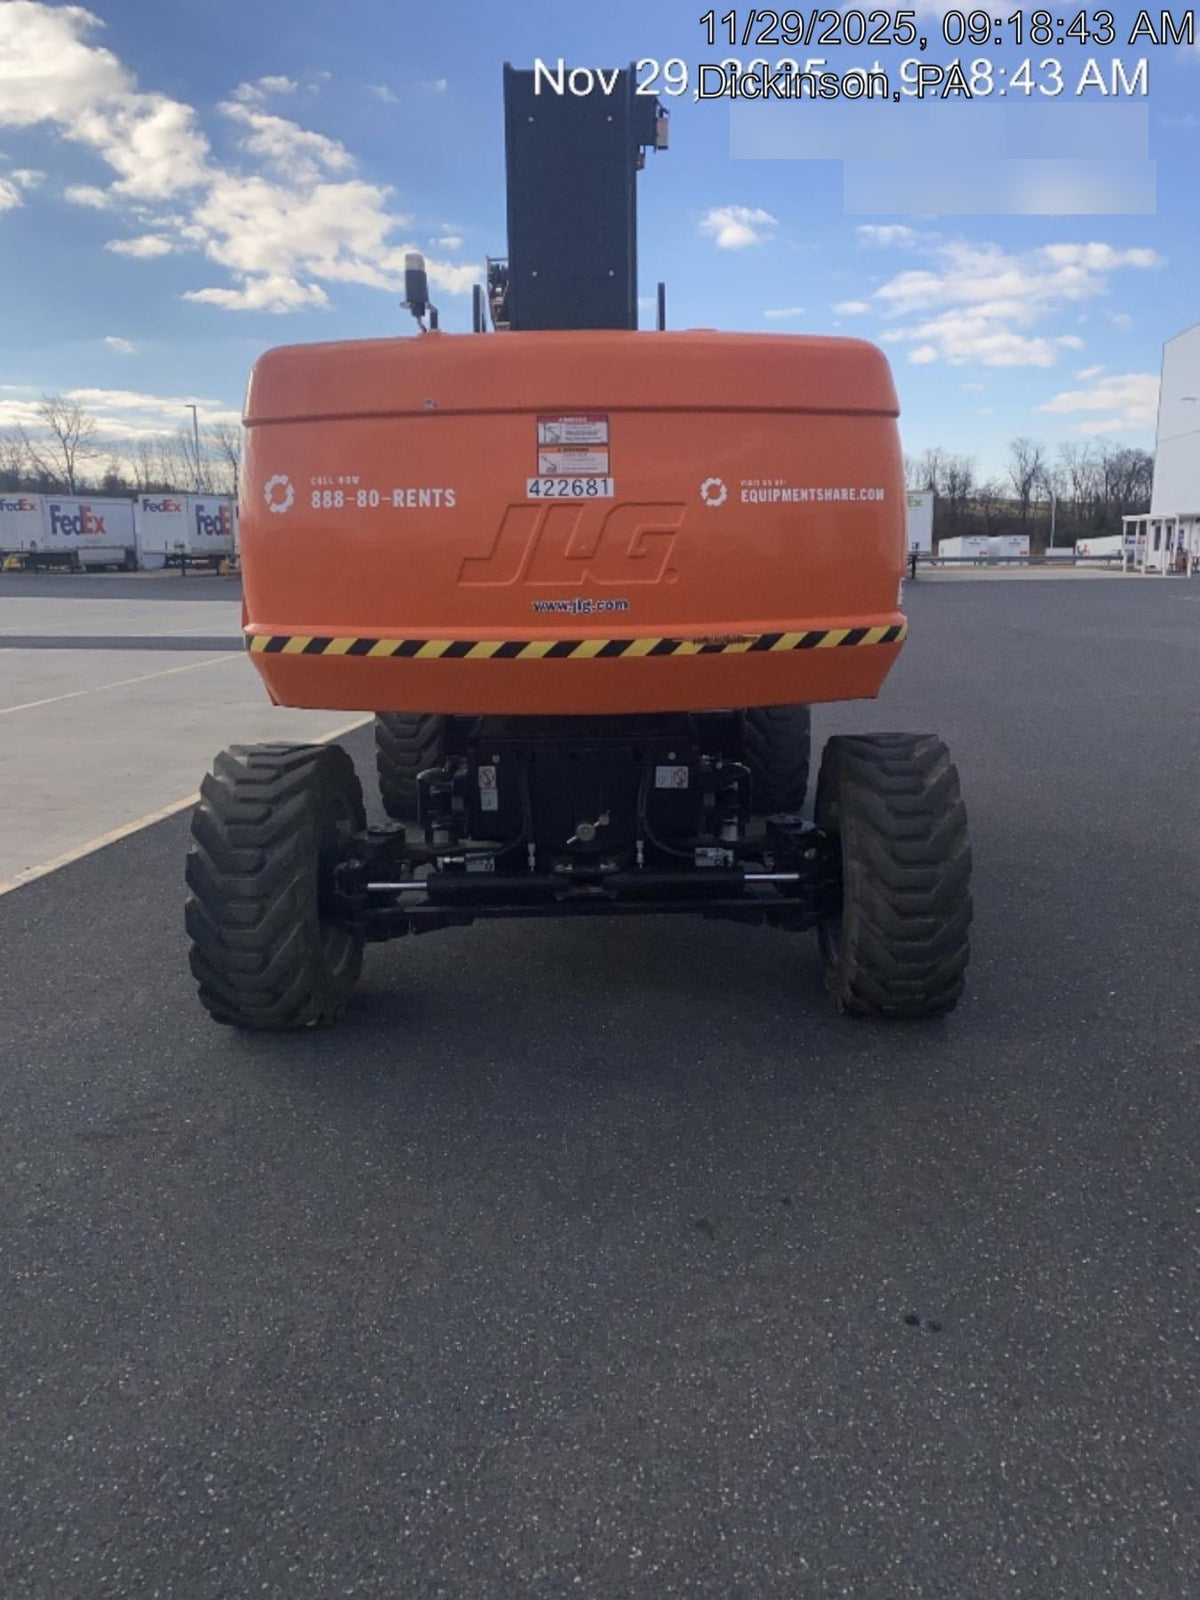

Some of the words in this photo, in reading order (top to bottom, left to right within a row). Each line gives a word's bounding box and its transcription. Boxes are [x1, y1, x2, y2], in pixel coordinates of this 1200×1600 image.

[529, 479, 609, 496] 422681
[740, 487, 885, 503] EQUIPMENTSHARE.COM
[143, 499, 182, 512] FedEx
[311, 489, 456, 508] 888-80-RENTS
[50, 504, 106, 535] FedEx
[195, 504, 230, 536] FedE
[533, 598, 629, 614] www.jlg.com
